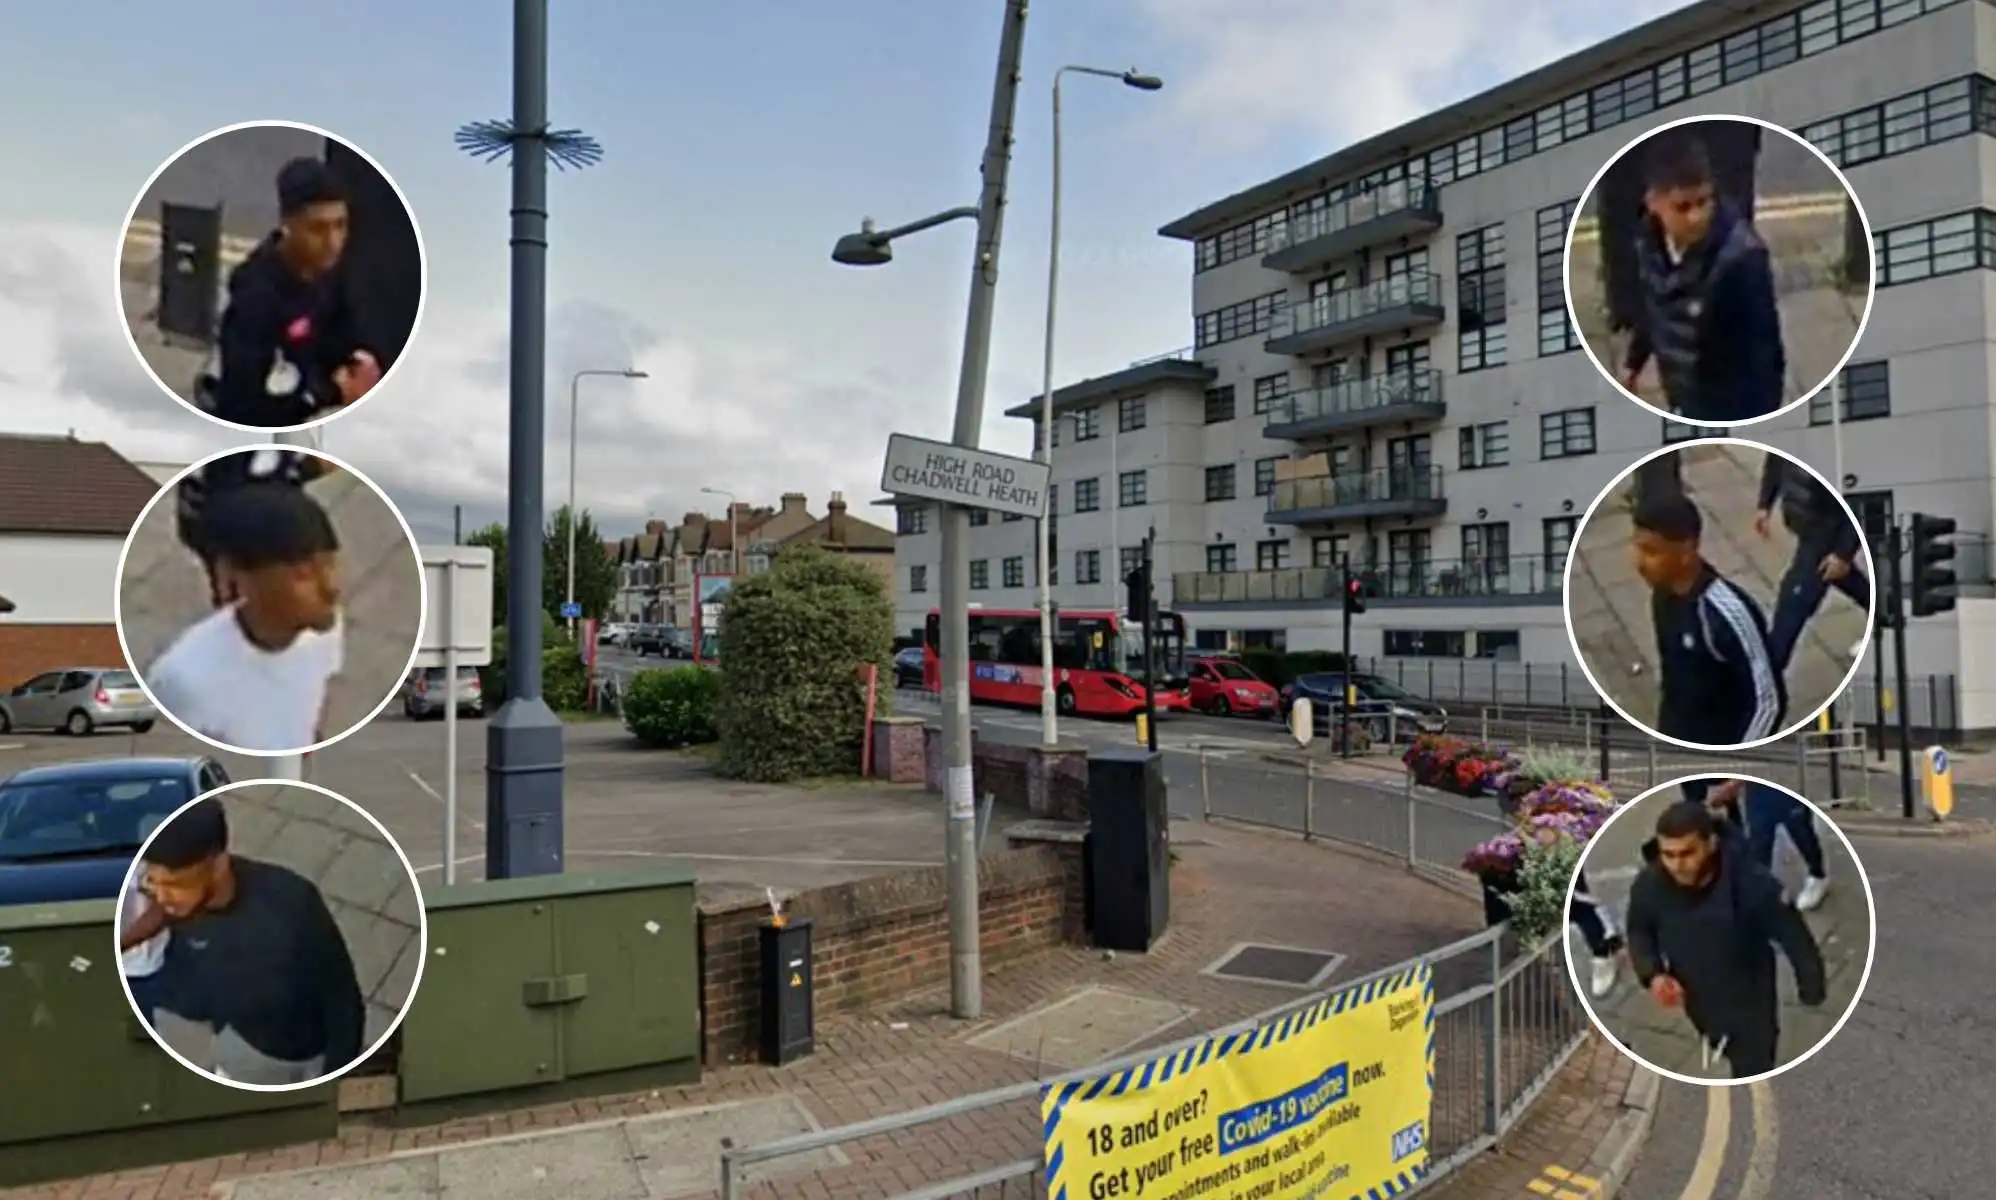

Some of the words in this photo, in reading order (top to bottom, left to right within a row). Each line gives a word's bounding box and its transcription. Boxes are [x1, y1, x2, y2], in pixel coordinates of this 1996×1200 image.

[892, 465, 980, 496] CHADWELL
[988, 484, 1038, 508] HEATH
[925, 453, 966, 475] HIGH
[972, 463, 1015, 485] ROAD
[1087, 1124, 1114, 1157] 18
[1120, 1109, 1159, 1148] and
[1164, 1088, 1208, 1132] over?
[1089, 1166, 1129, 1200] Get
[1135, 1151, 1175, 1196] your
[1179, 1133, 1213, 1166] free
[1222, 1097, 1296, 1145] Covid-19
[1352, 1060, 1386, 1088] now.
[1394, 1121, 1424, 1163] NHS
[1243, 1147, 1269, 1174] and
[1279, 1160, 1307, 1190] local
